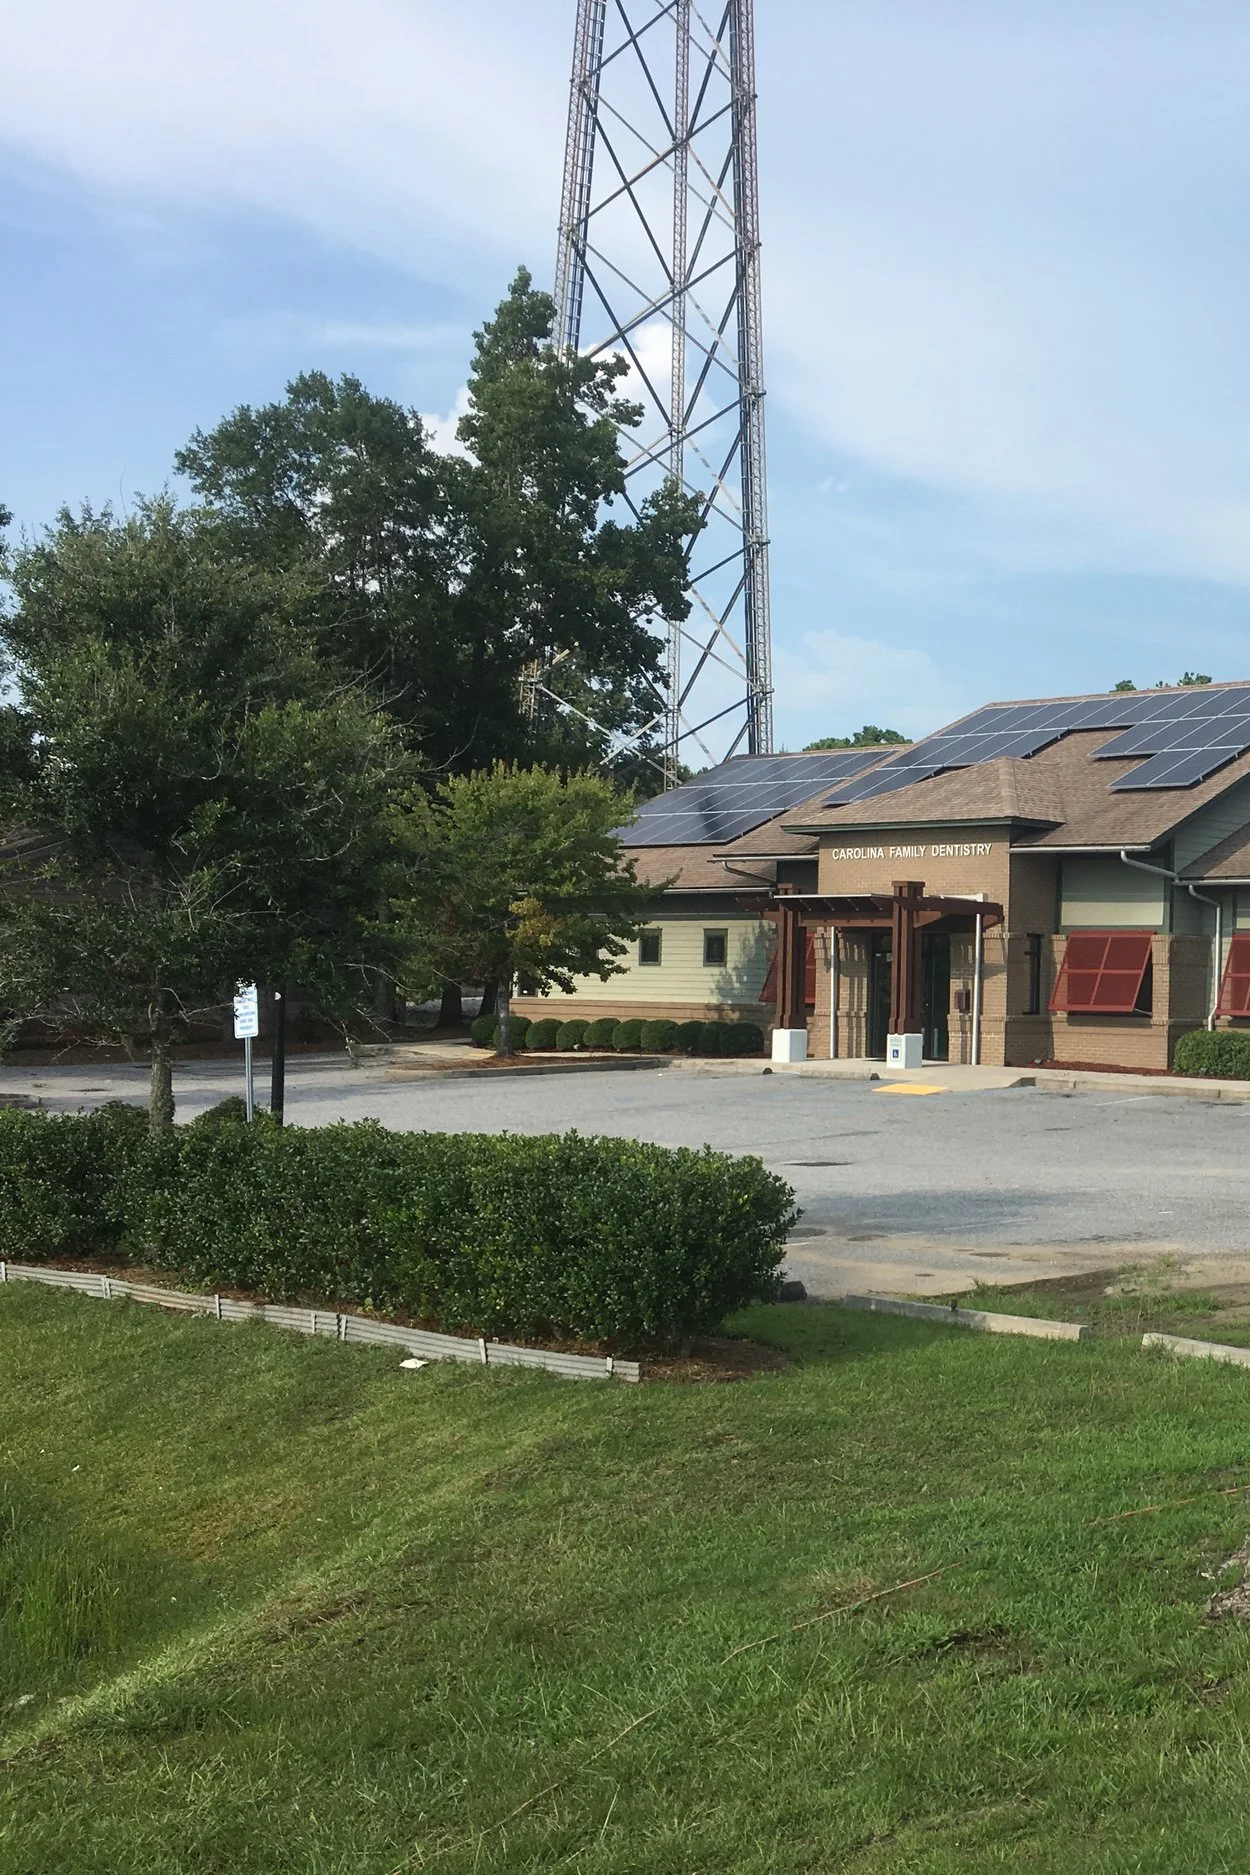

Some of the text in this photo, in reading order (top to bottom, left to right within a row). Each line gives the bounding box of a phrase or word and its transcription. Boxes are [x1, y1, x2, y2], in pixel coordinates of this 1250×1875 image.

[832, 843, 993, 860] CAROLINA FAMILY DENTISTRY
